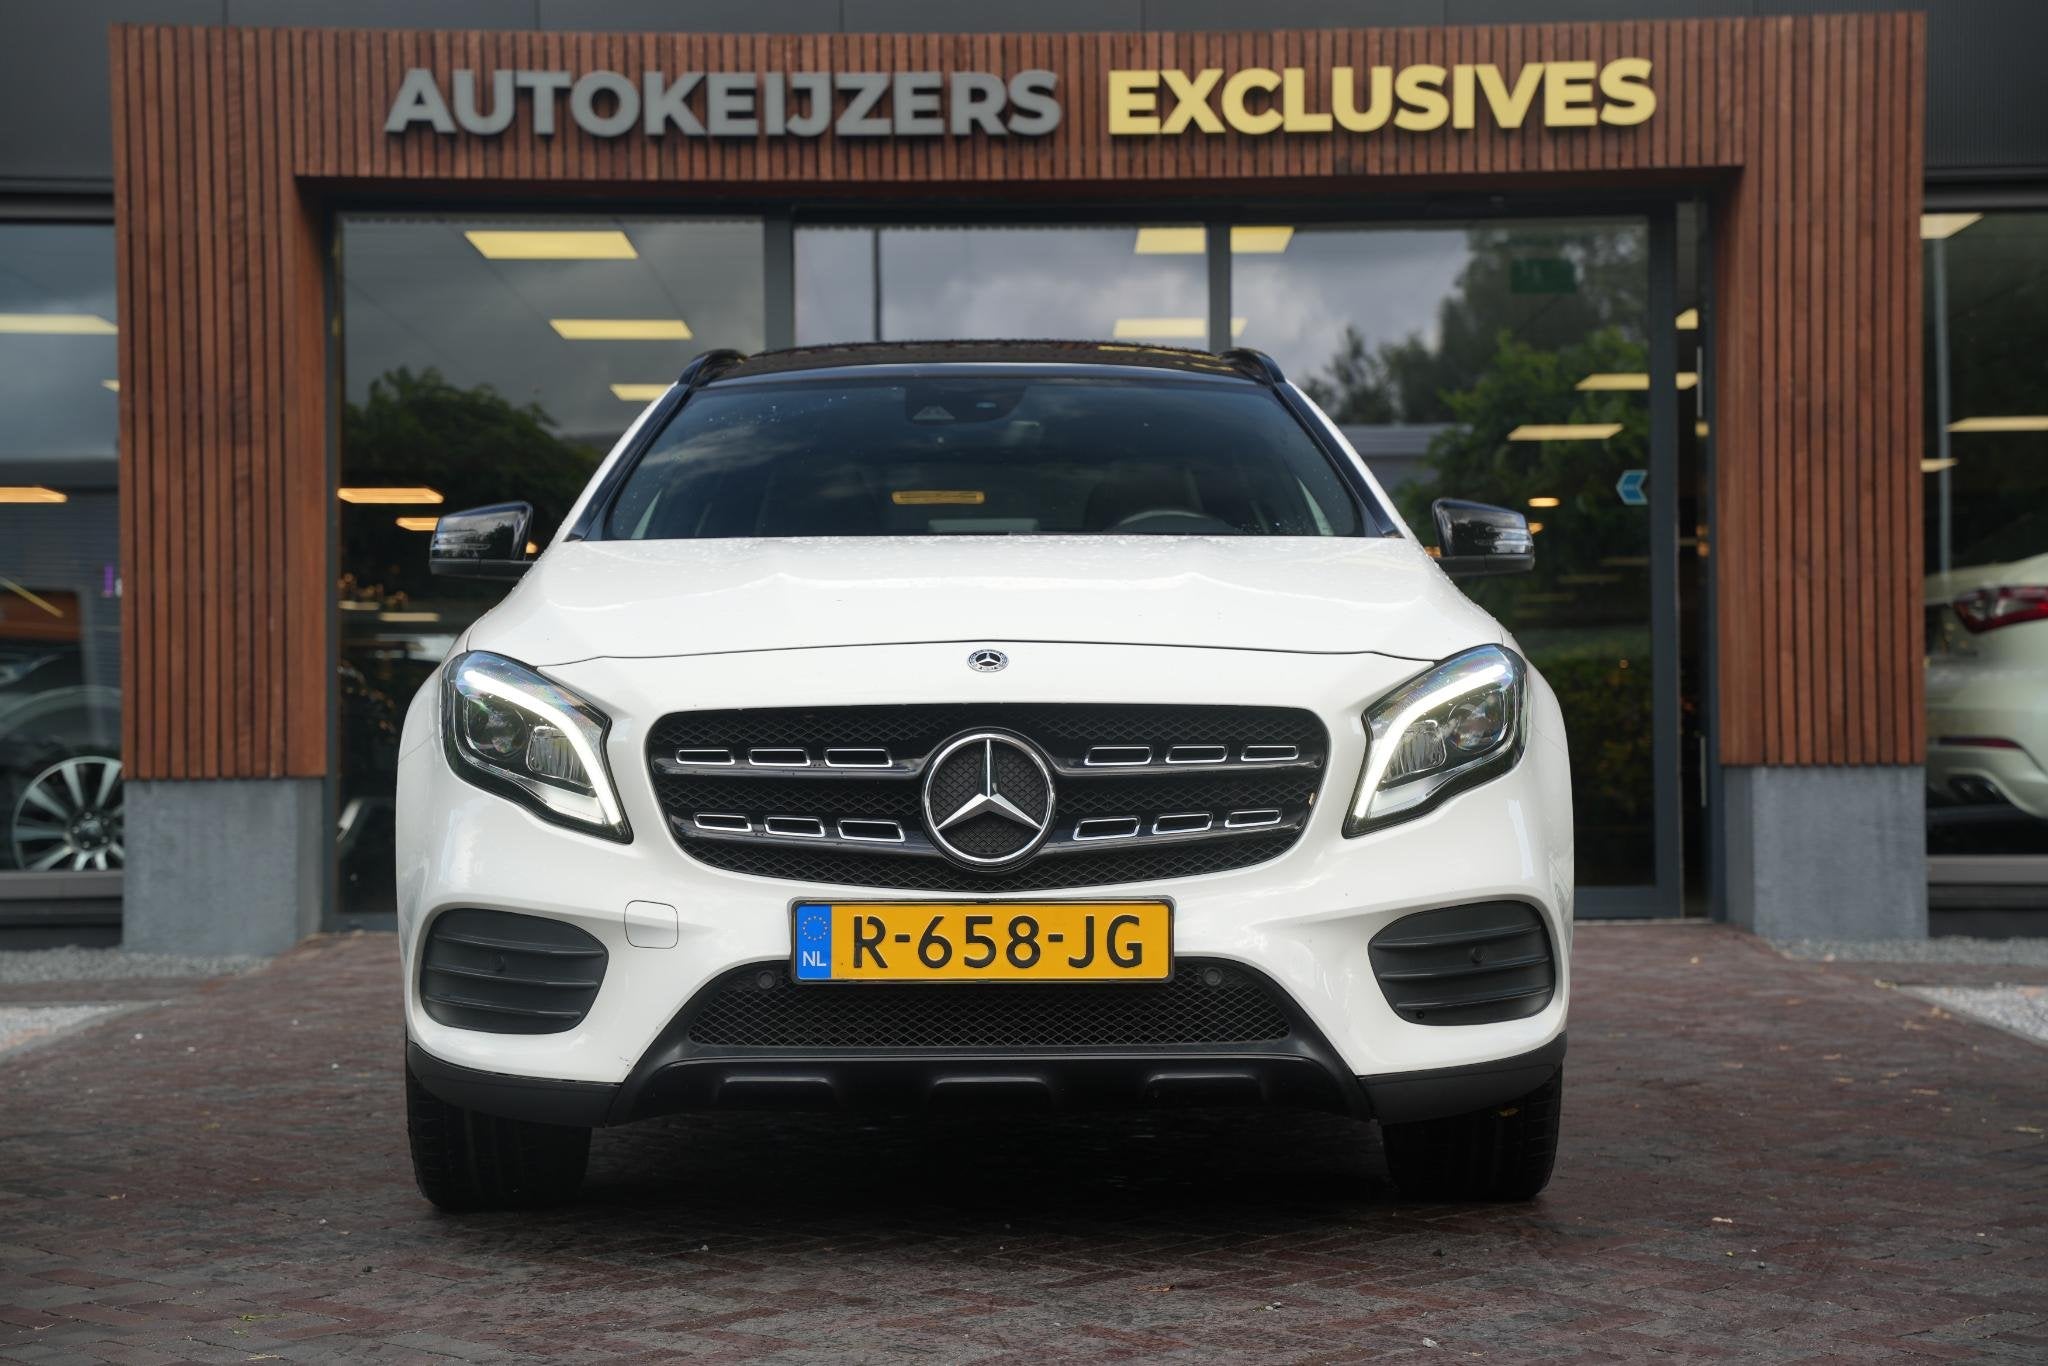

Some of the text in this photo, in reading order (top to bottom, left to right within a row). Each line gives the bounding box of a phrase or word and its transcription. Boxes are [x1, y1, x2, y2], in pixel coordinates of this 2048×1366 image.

[384, 57, 1657, 137] AUTOKEIJZERS EXCLUSIVES
[802, 951, 827, 967] NL
[852, 914, 1143, 969] R-658-JG
